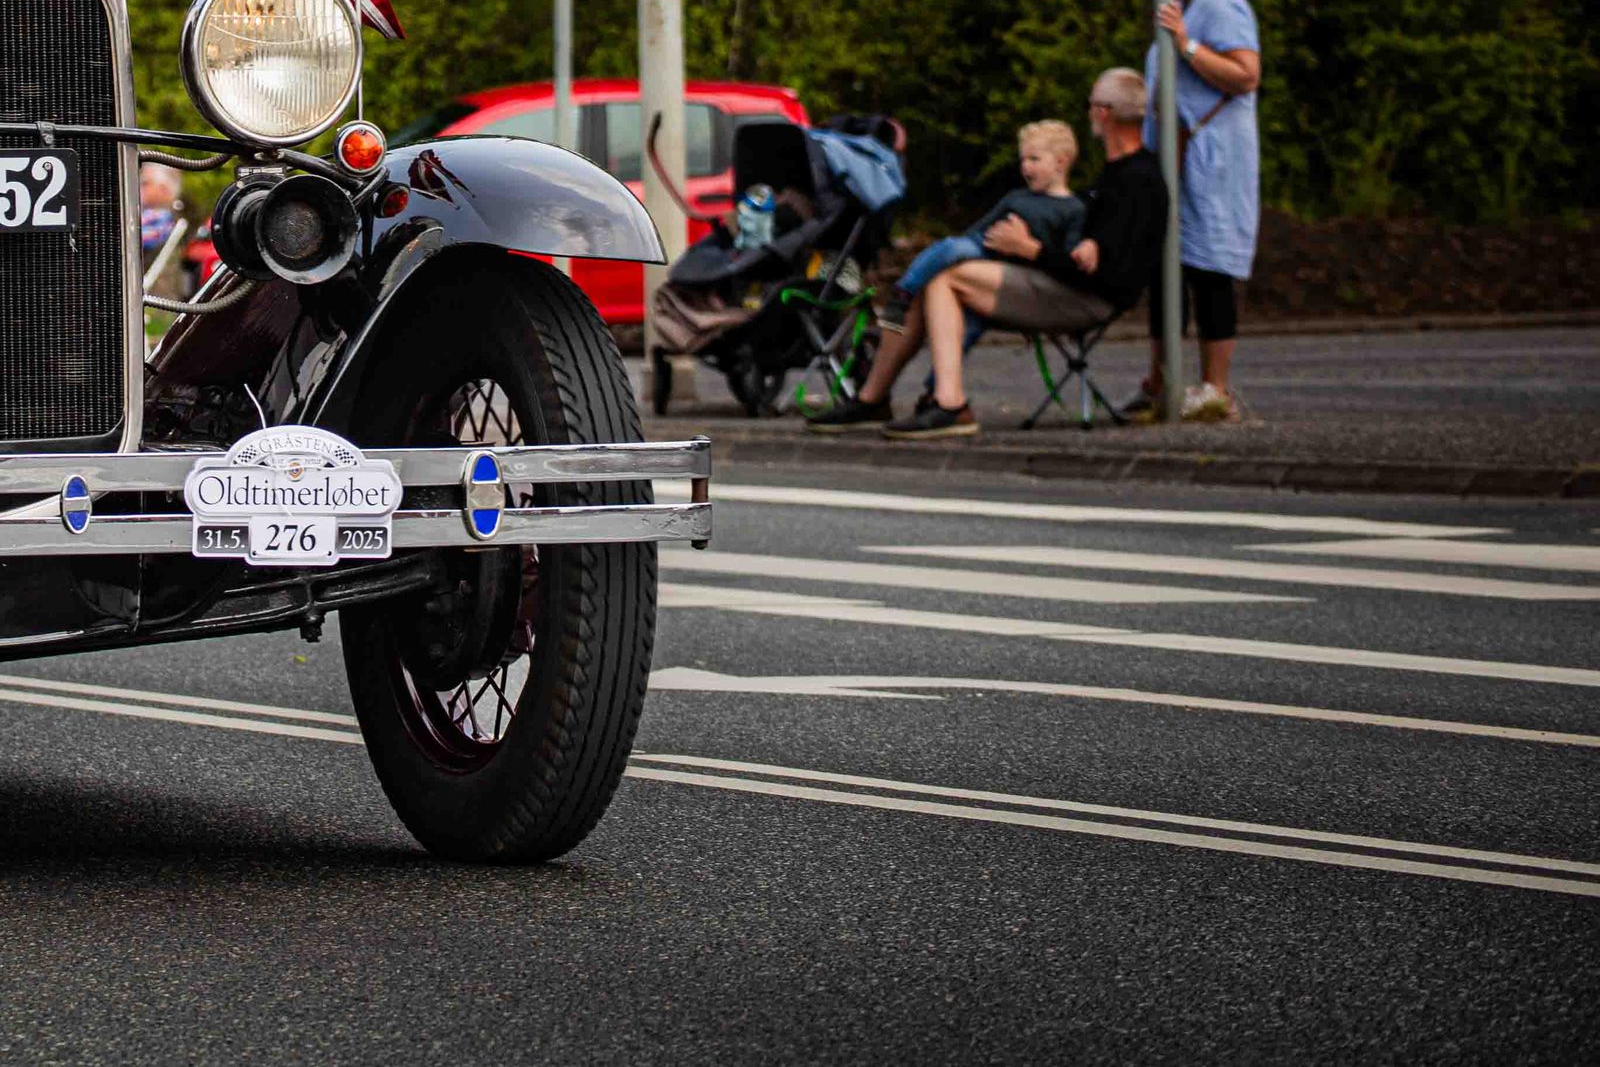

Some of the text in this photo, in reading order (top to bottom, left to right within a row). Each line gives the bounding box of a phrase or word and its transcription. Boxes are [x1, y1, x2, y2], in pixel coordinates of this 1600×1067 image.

[258, 433, 333, 454] GRÅSTEN
[198, 475, 391, 510] Oldtimerløbet
[202, 524, 384, 552] 31.5. 276 2025
